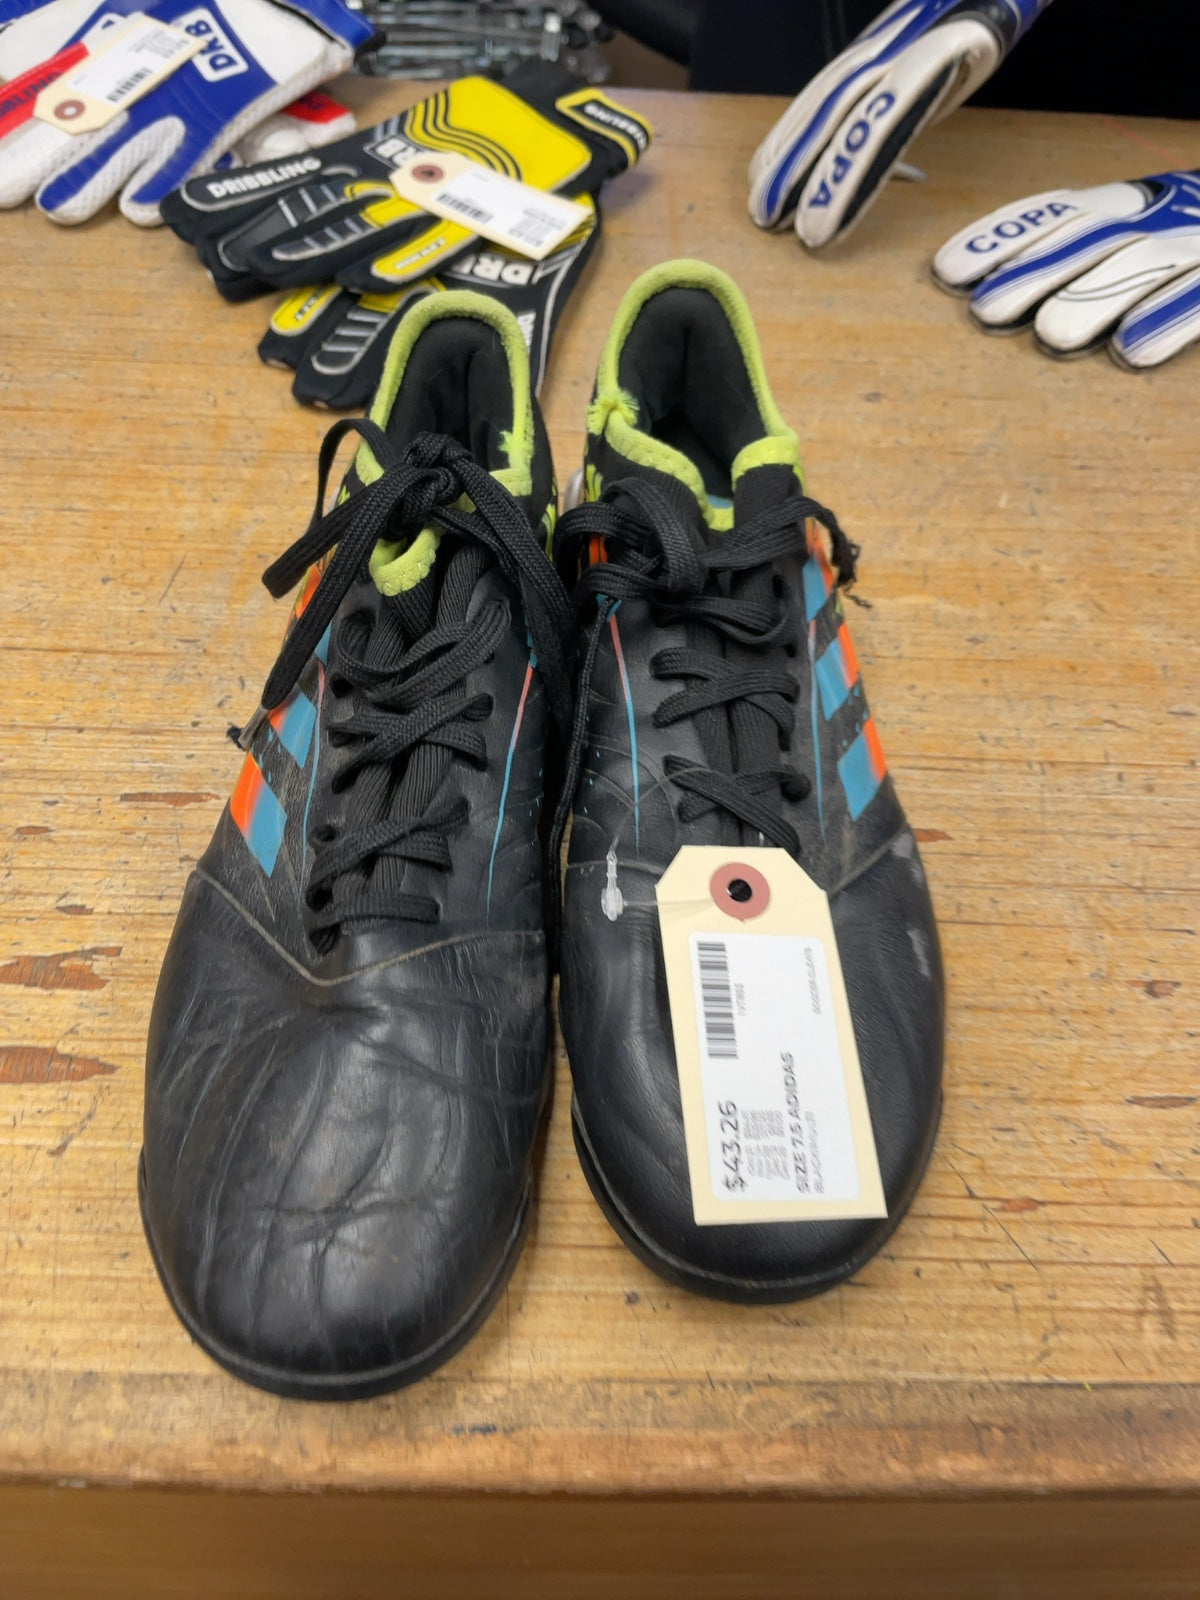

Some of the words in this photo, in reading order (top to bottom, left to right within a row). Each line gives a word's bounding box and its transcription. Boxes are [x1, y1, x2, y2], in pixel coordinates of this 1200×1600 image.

[206, 155, 322, 198] DRIBBLING
[807, 90, 898, 210] COPA
[964, 198, 1079, 255] COPA
[780, 1051, 801, 1120] ADIDAS
[718, 1100, 748, 1194] $43.26
[793, 1153, 811, 1195] SIZE
